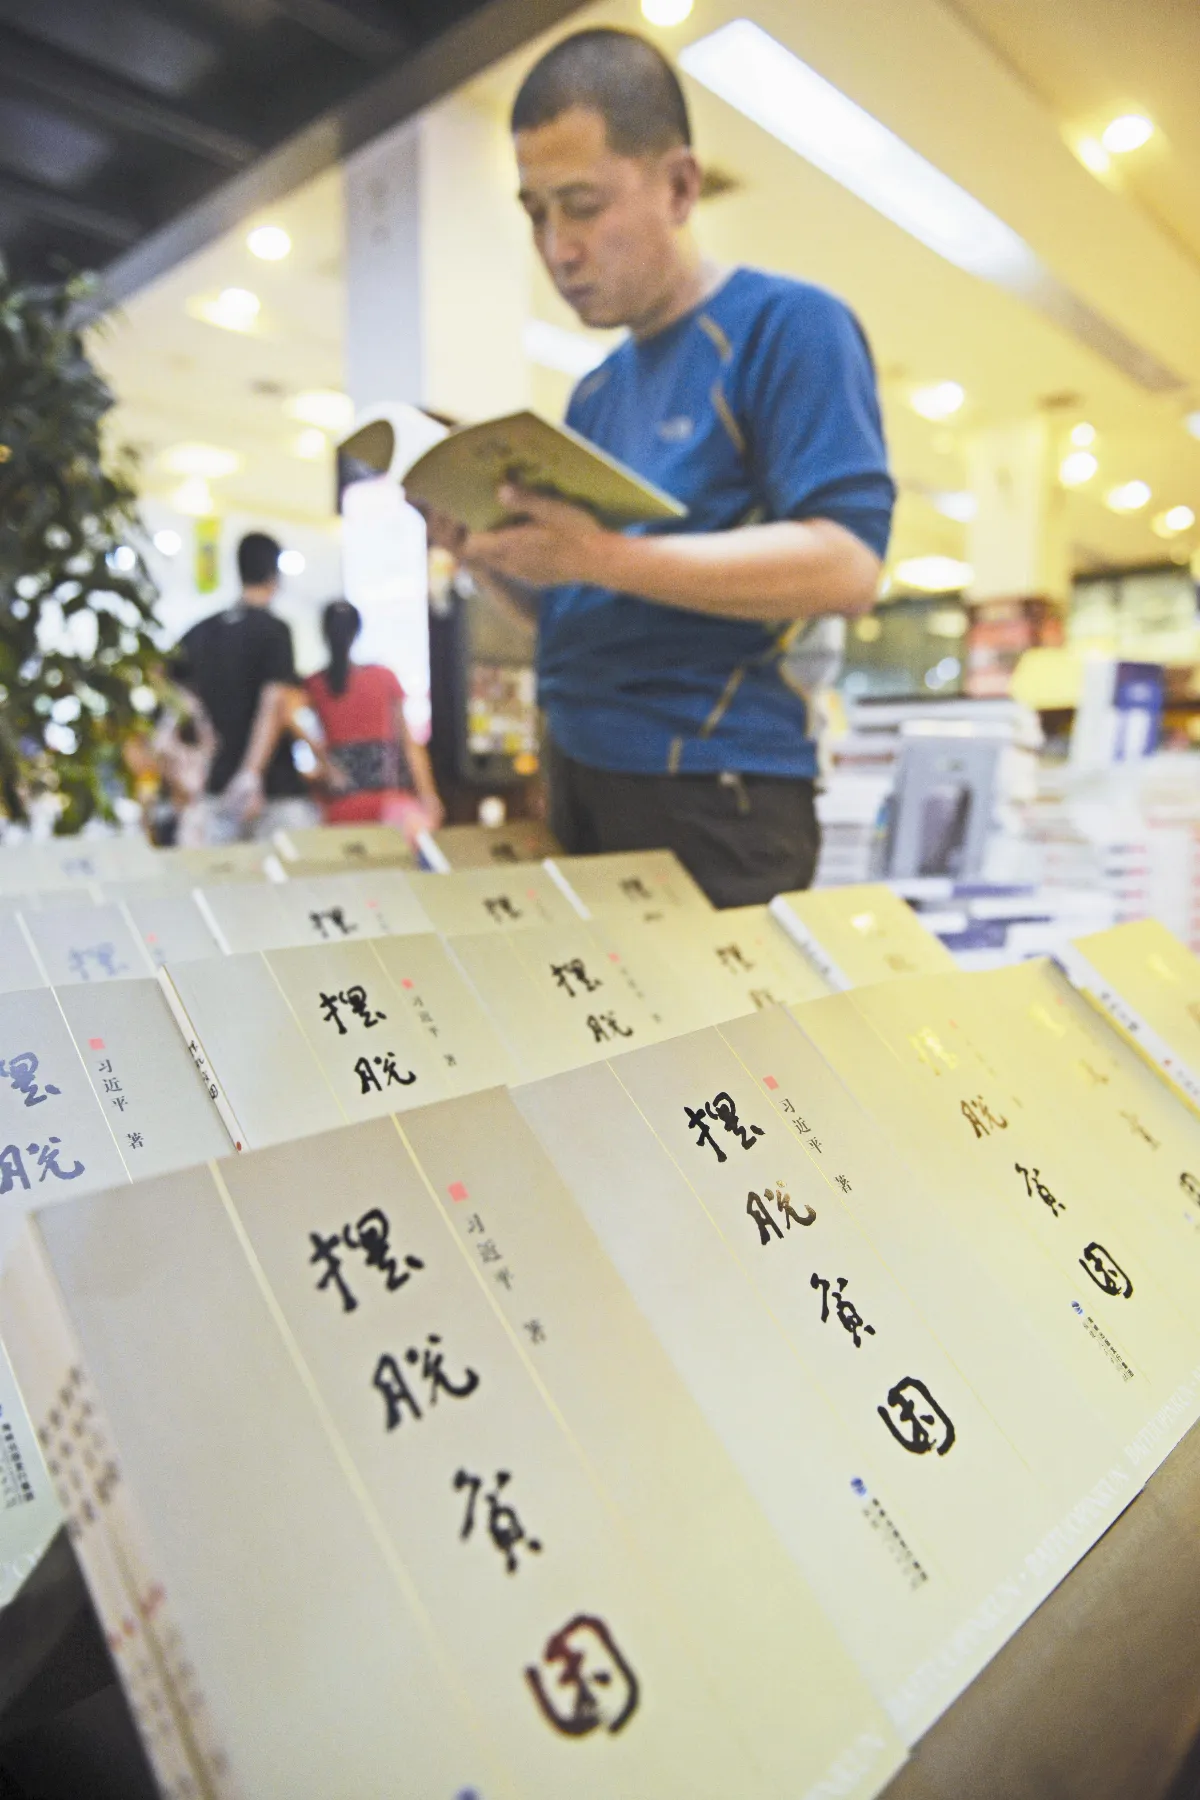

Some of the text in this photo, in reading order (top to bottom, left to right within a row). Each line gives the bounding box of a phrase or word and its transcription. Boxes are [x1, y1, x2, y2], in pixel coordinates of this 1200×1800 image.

[319, 985, 417, 1095] 摆脱
[98, 1058, 145, 1150] 习近平 著
[779, 1098, 852, 1193] 习近平 著
[467, 1212, 514, 1291] 习近平
[684, 1091, 956, 1457] 摆脱贫困
[309, 1207, 641, 1739] 摆脱贫困
